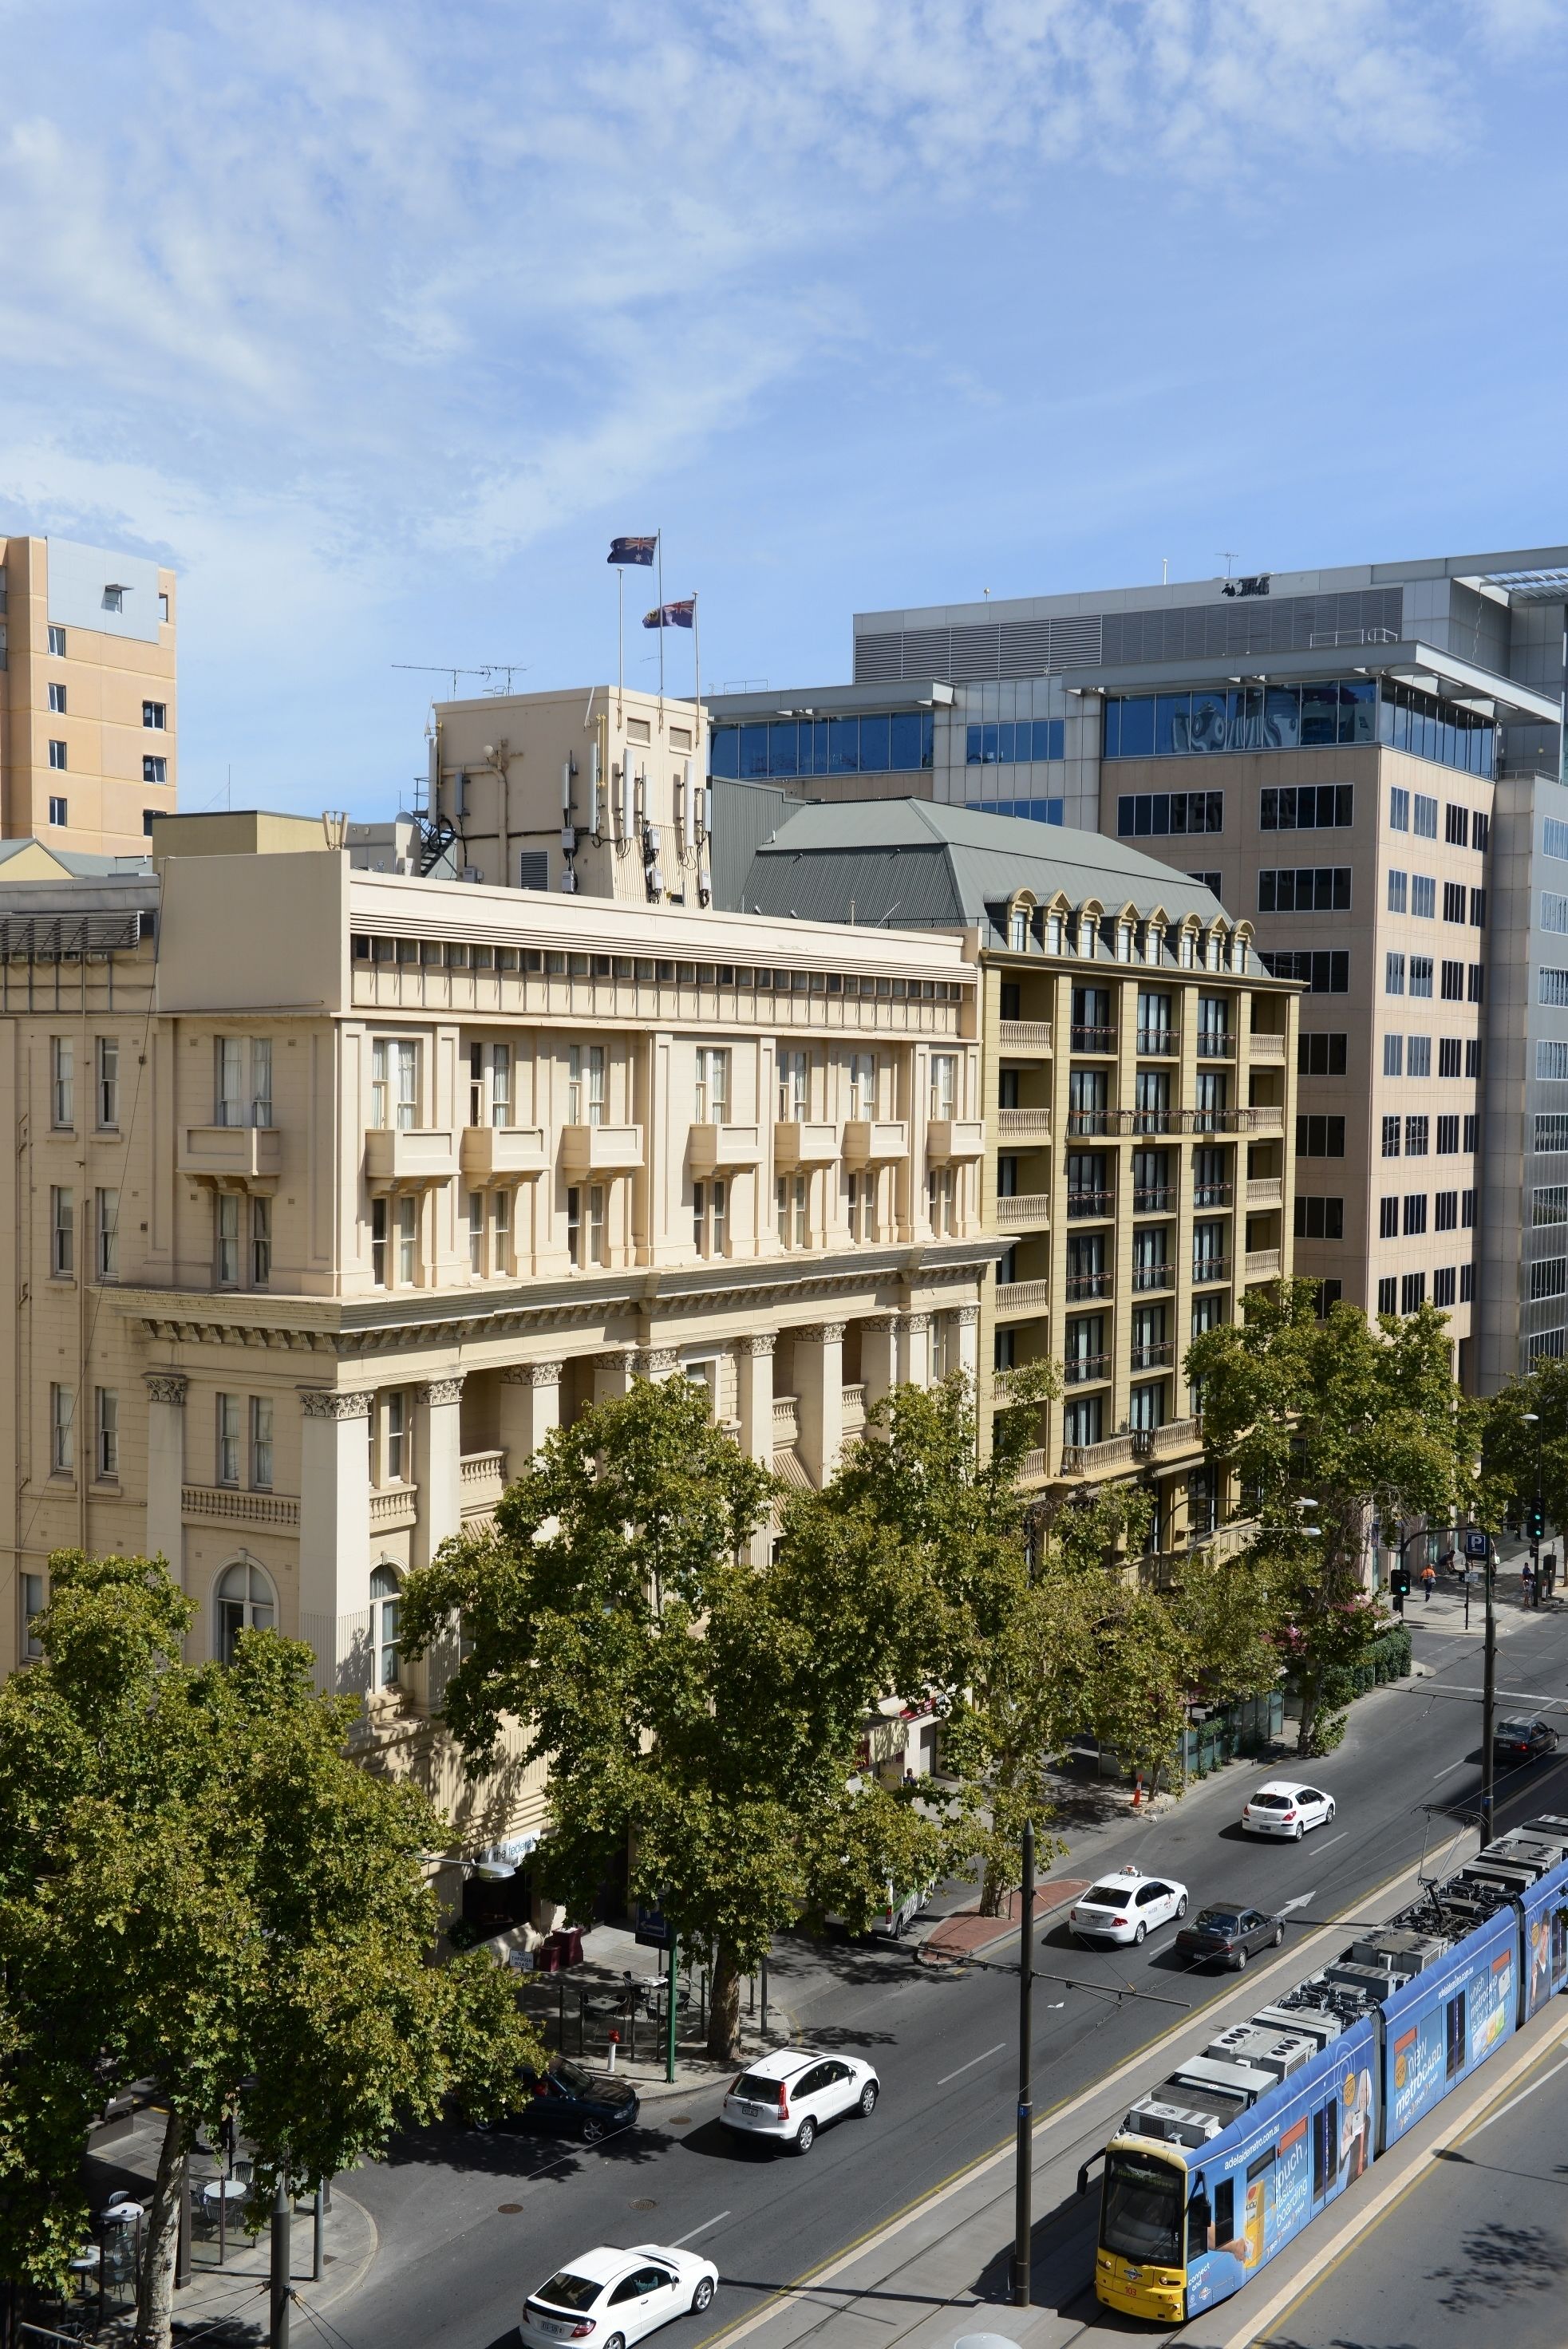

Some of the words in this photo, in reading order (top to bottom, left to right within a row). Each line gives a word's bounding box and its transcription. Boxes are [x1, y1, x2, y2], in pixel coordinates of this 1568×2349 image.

[1471, 1536, 1482, 1547] P
[493, 1850, 506, 1861] the
[1438, 1966, 1474, 2000] adelaidemetro.com.au
[1469, 1976, 1485, 2004] which
[1471, 2021, 1477, 2035] is
[1408, 2036, 1428, 2076] new
[1396, 2043, 1442, 2119] metroCARD
[1415, 2090, 1425, 2108] TRAIN
[1428, 2072, 1439, 2089] TRAM
[1224, 2123, 1280, 2170] adelaidemetro.com.au
[1276, 2175, 1296, 2209] faster
[1276, 2179, 1308, 2229] boarding
[1295, 2201, 1305, 2217] TRAM
[1188, 2262, 1211, 2286] connect
[1191, 2275, 1202, 2292] and
[1125, 2286, 1136, 2296] 103
